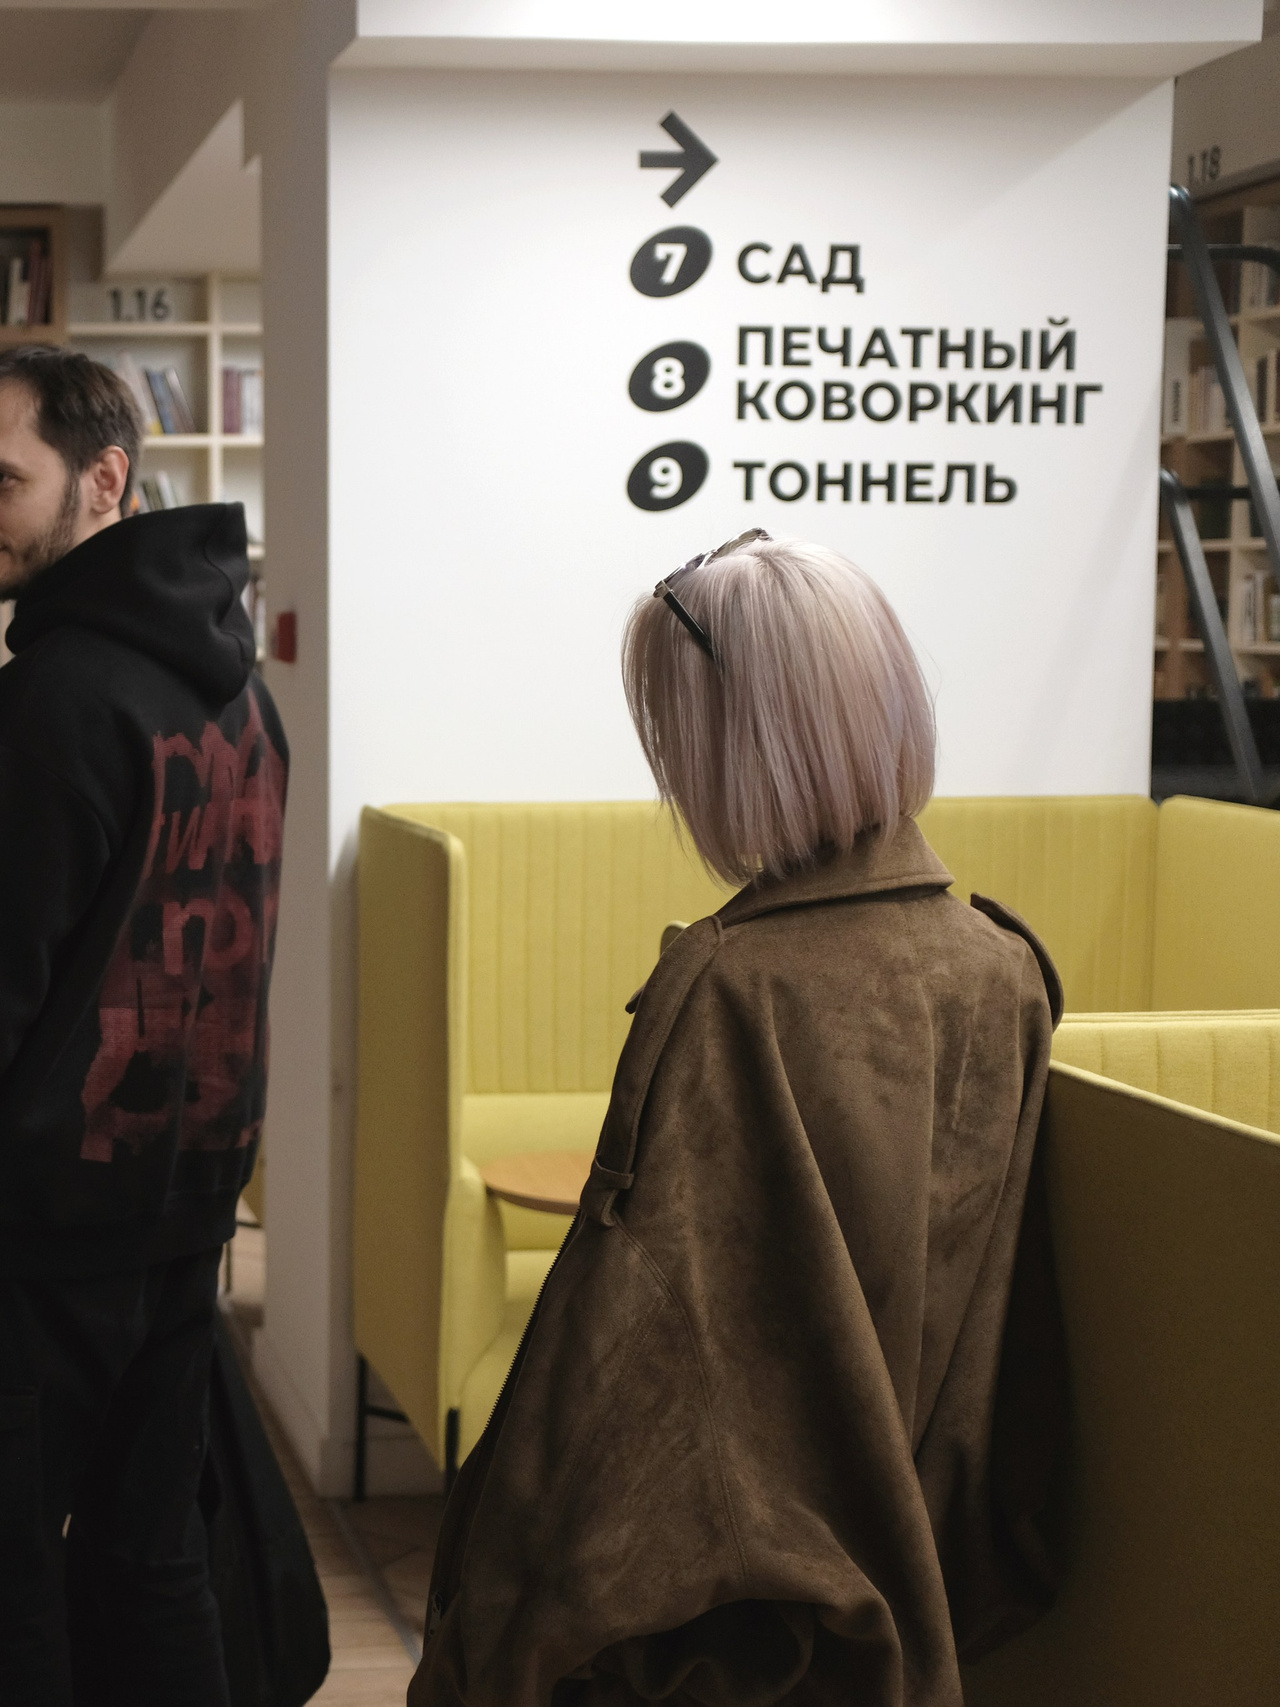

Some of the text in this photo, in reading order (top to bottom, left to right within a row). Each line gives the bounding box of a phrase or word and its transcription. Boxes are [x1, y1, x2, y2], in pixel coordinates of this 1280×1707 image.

[653, 242, 866, 294] 7 САД
[109, 287, 170, 321] 1.16
[737, 317, 1077, 371] ПЕЧАТНЫЙ
[650, 355, 687, 398] 8
[736, 379, 1104, 425] КОВОРКИНГ
[648, 456, 1018, 504] 9 ТОННЕЛЬ
